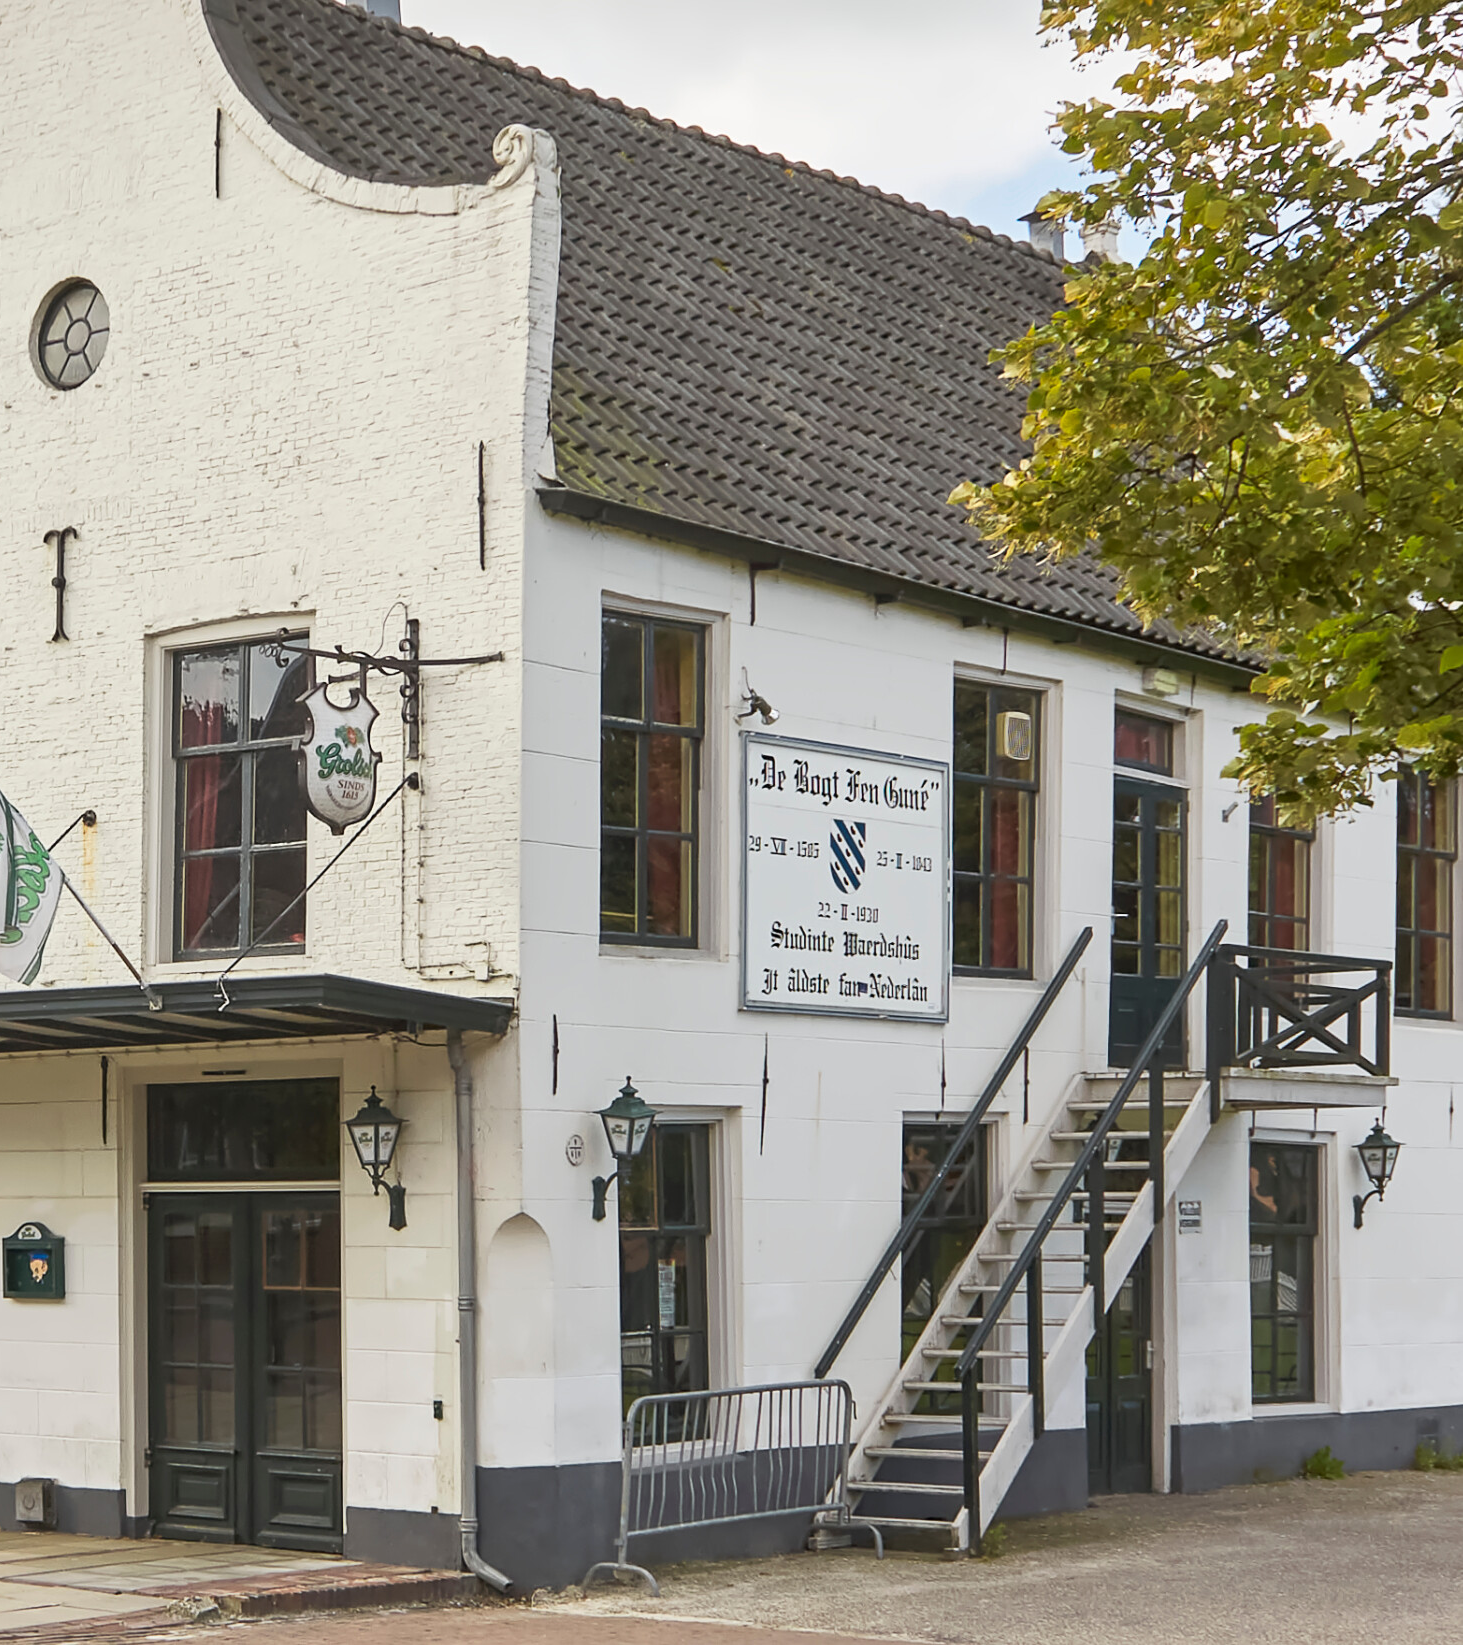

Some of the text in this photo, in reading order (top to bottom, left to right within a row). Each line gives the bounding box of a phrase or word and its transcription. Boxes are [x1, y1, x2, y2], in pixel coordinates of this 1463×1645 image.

[337, 780, 365, 790] SINDS
[794, 759, 839, 806] Bogt
[771, 921, 835, 953] Studinte
[839, 973, 861, 997] fan
[869, 973, 928, 1002] Nederlân
